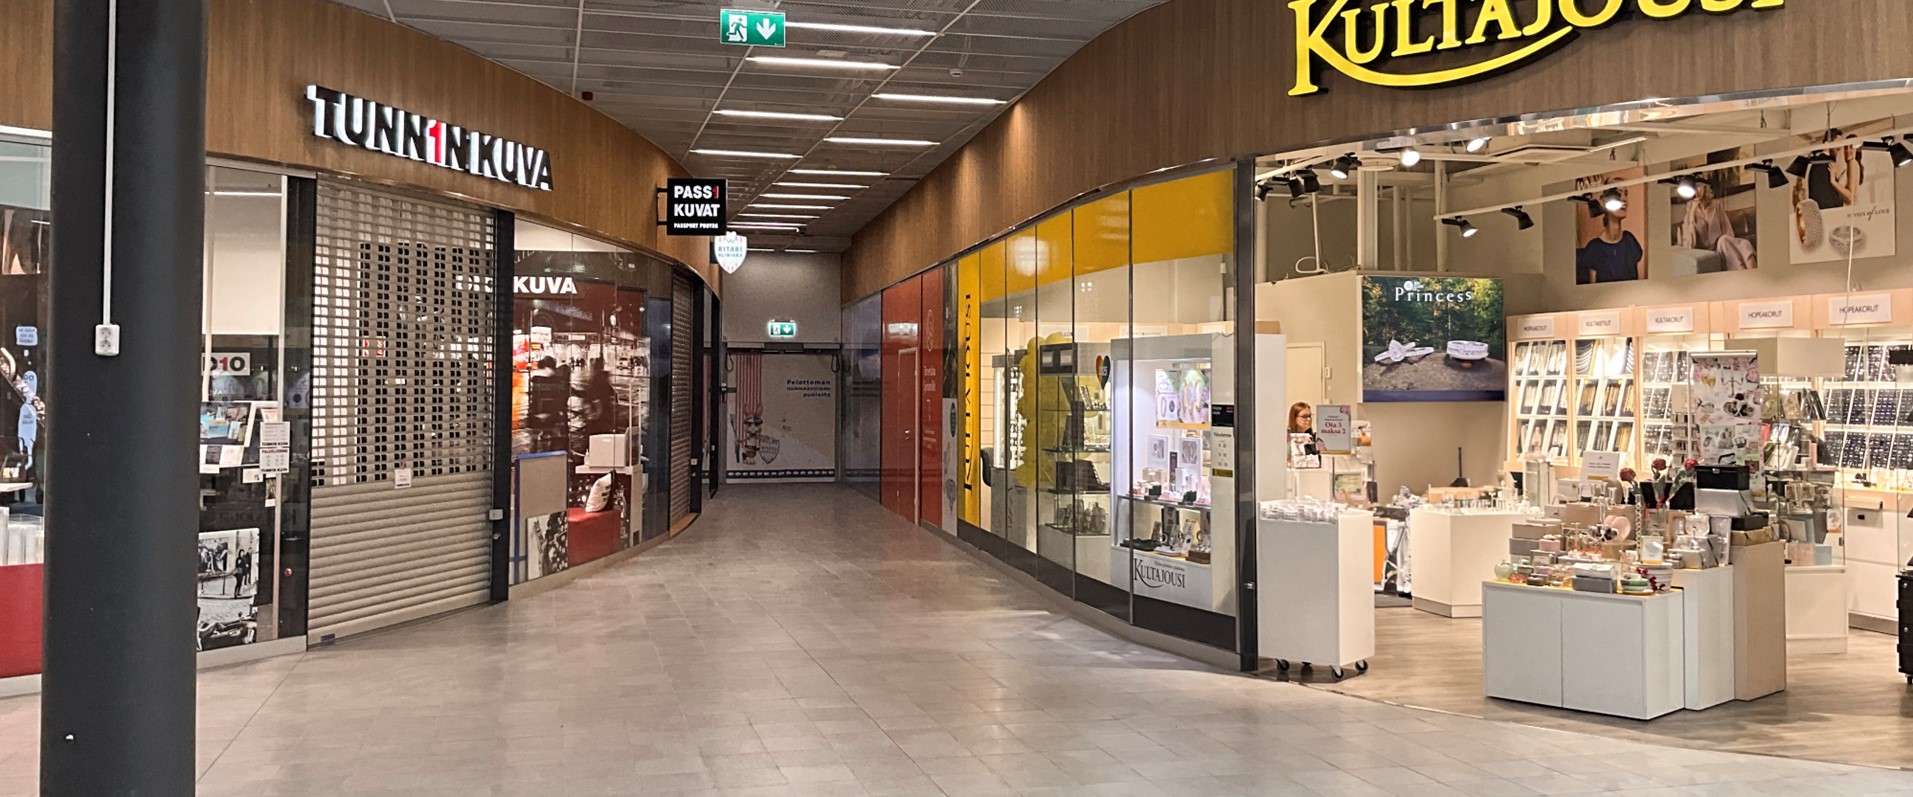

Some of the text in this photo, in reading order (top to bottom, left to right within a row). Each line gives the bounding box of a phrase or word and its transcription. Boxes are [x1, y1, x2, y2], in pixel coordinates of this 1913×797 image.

[469, 131, 554, 191] KUVA
[674, 185, 720, 199] PASS1
[674, 203, 721, 217] KUVAT
[718, 245, 743, 253] RITARI
[513, 275, 578, 295] KUVA
[1394, 286, 1473, 303] Princess
[1747, 310, 1783, 319] HOPEAKORUT
[1839, 303, 1880, 315] HOPEAKORUT
[786, 378, 831, 386] Pelottoman
[1133, 558, 1186, 588] KULTAJOUSI
